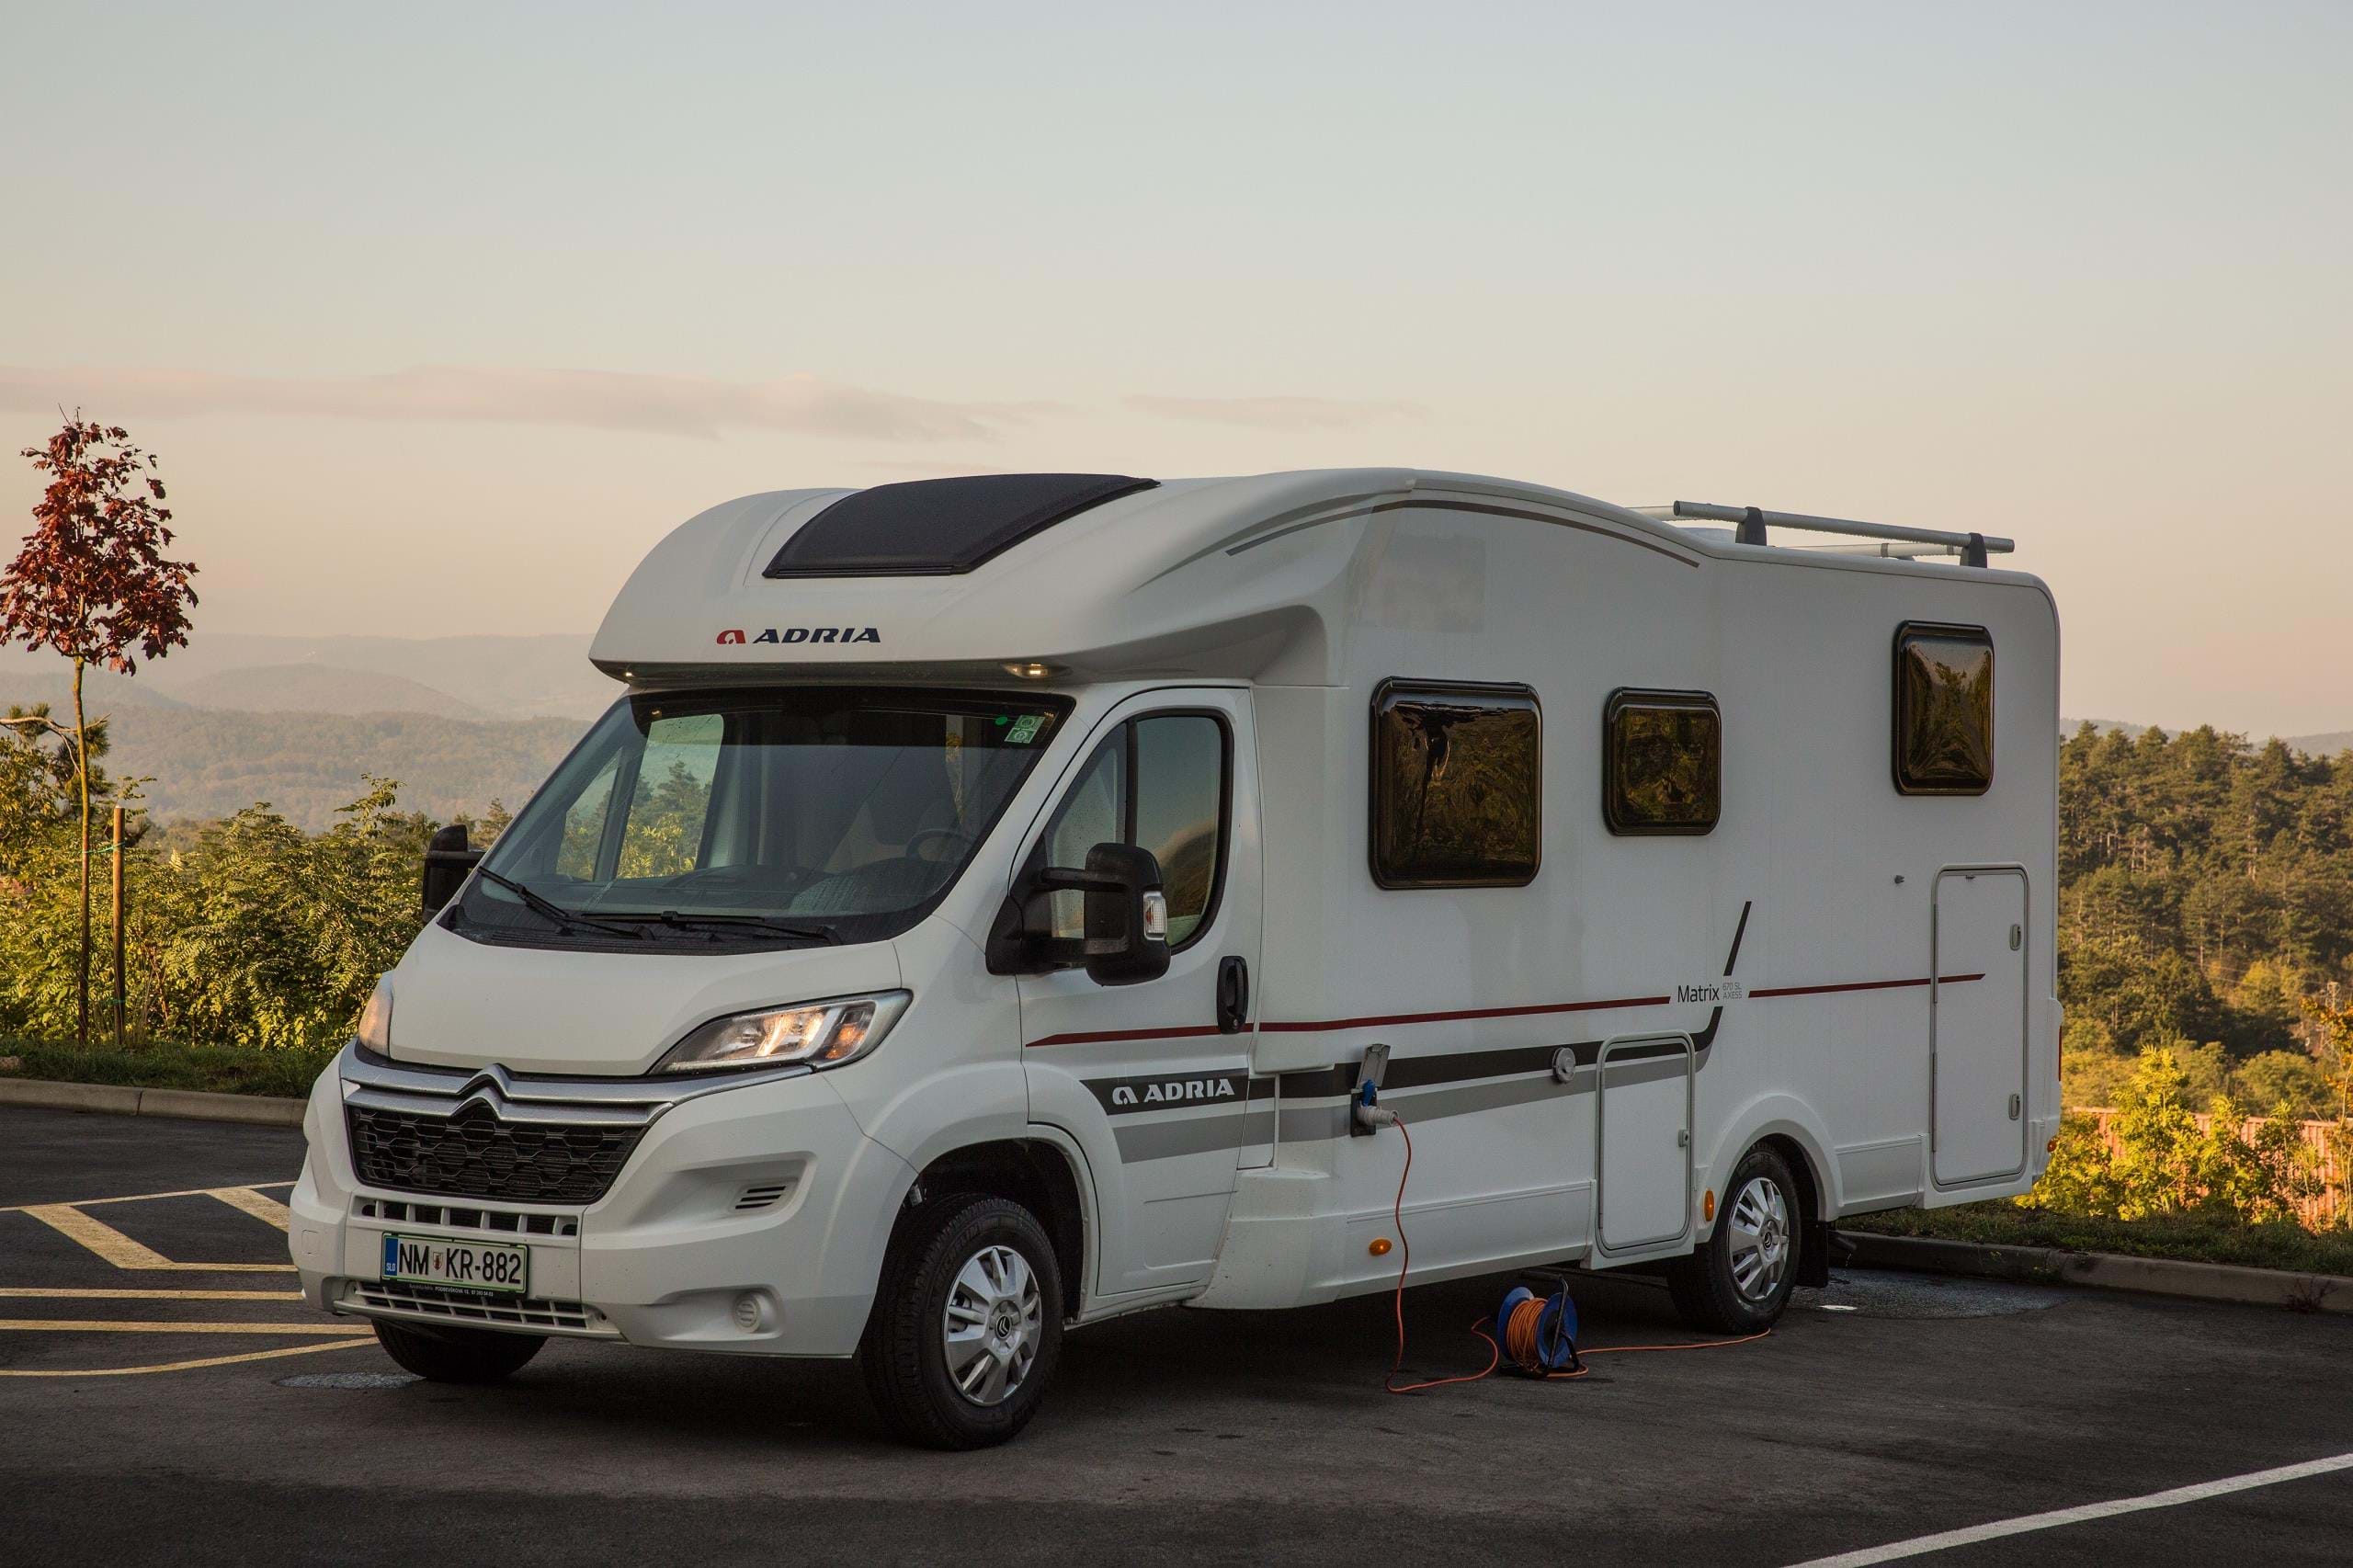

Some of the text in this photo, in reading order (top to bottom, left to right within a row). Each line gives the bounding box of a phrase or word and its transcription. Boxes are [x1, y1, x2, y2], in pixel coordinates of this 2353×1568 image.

[752, 628, 881, 644] ADRIA
[1677, 983, 1720, 1004] Matrix
[1722, 991, 1743, 1000] AXESS
[1143, 1078, 1235, 1103] ADRIA
[386, 1262, 396, 1272] SLO
[399, 1243, 521, 1284] NM KR-882
